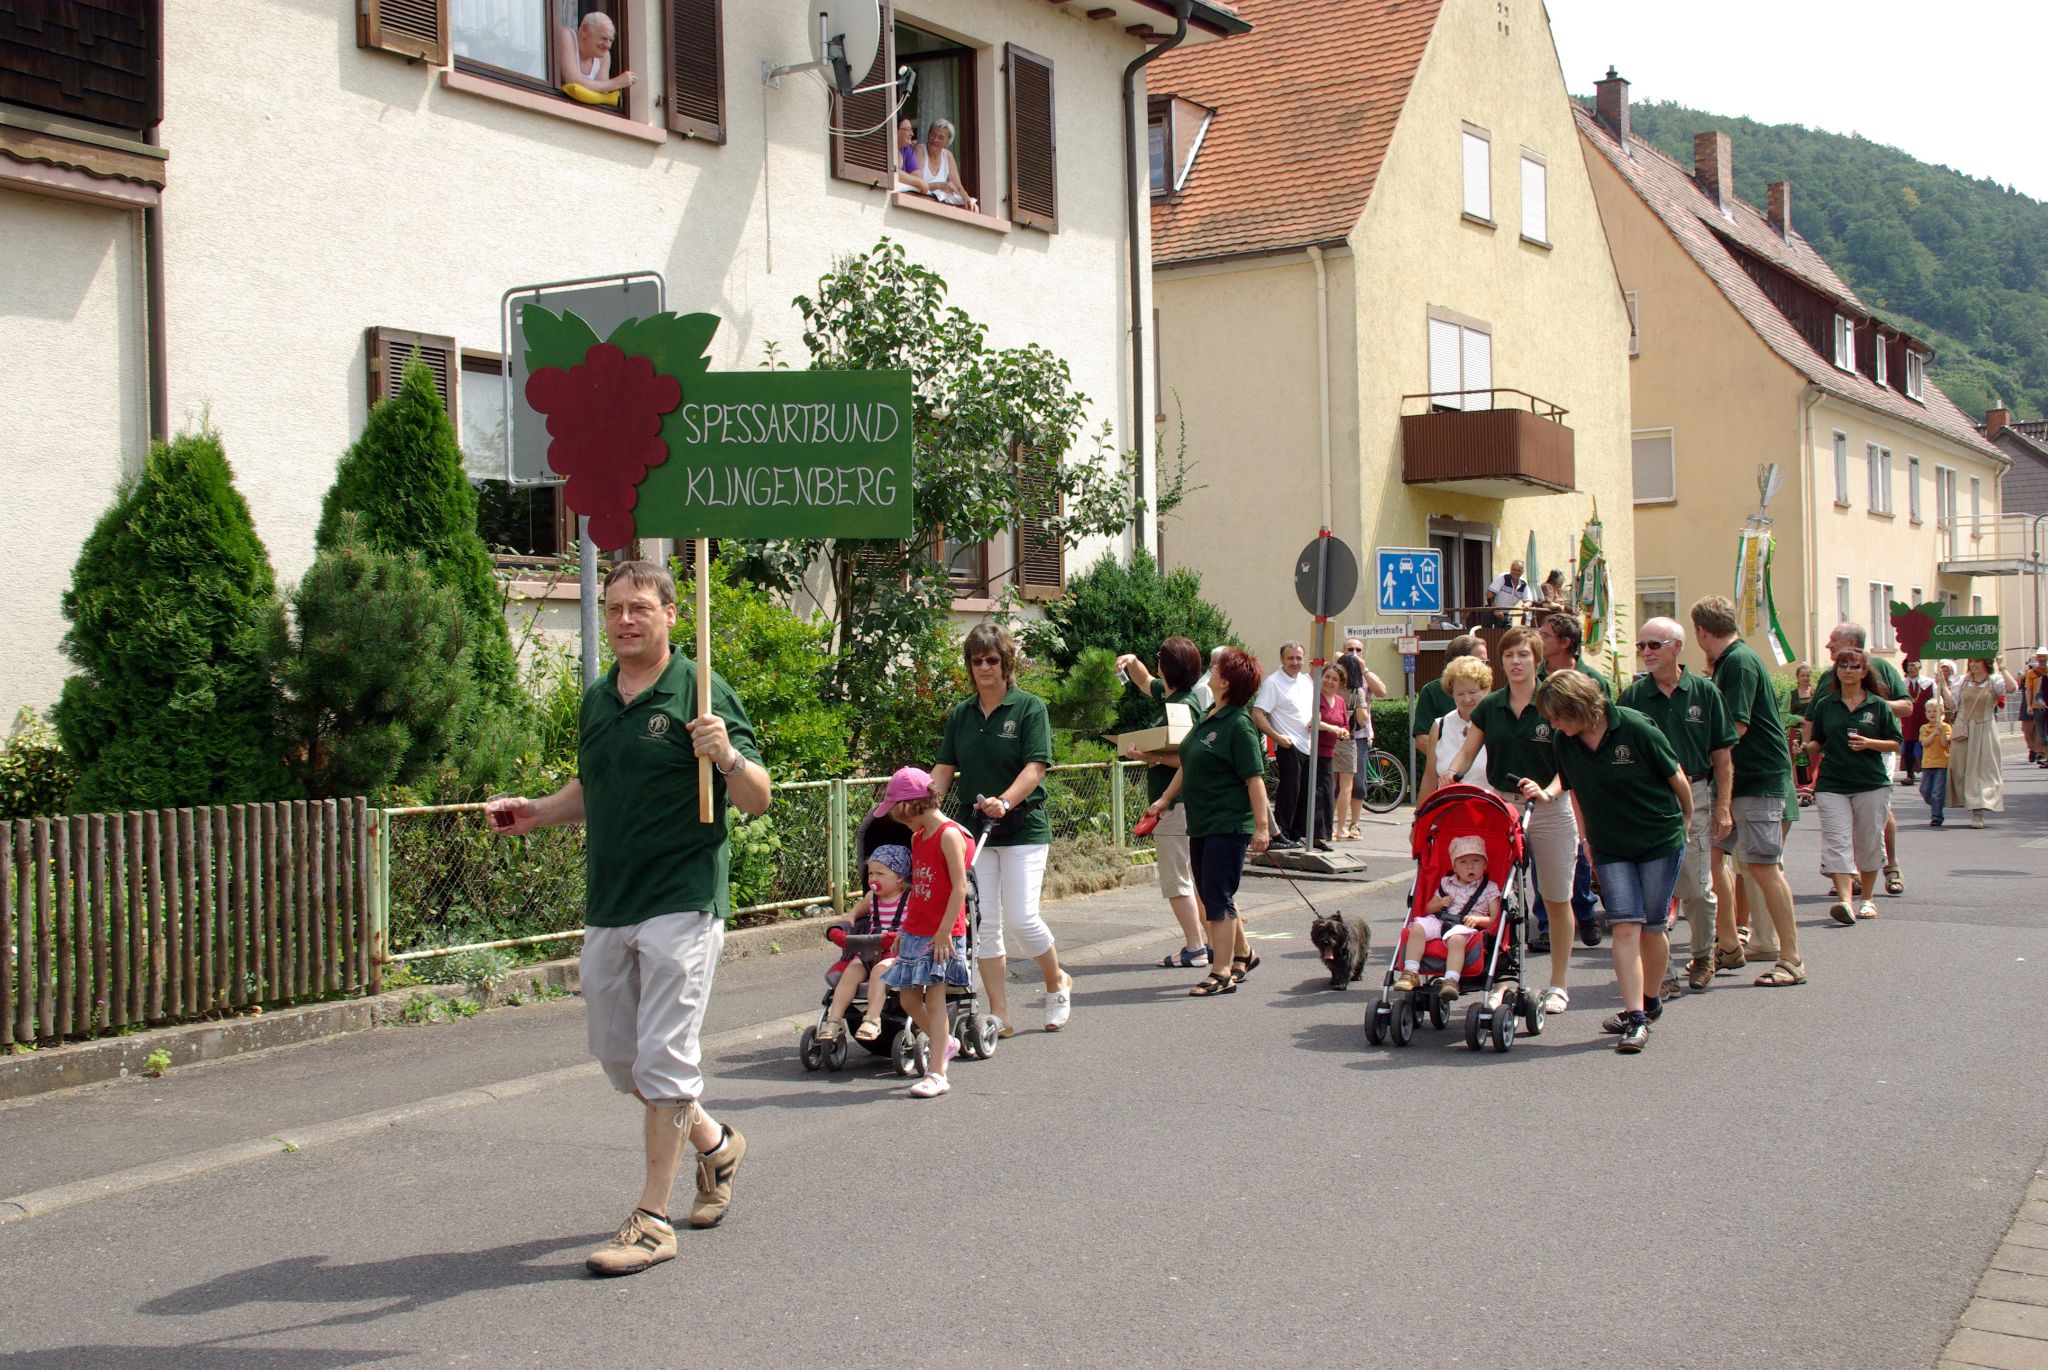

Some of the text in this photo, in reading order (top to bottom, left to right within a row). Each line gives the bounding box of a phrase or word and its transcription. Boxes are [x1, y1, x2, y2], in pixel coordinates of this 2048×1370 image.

[682, 403, 899, 444] SPESSARTBUND
[685, 467, 896, 506] KLINGENBERG
[1347, 626, 1403, 637] Weingartenstraße
[1935, 640, 1998, 651] KLINGENBERG
